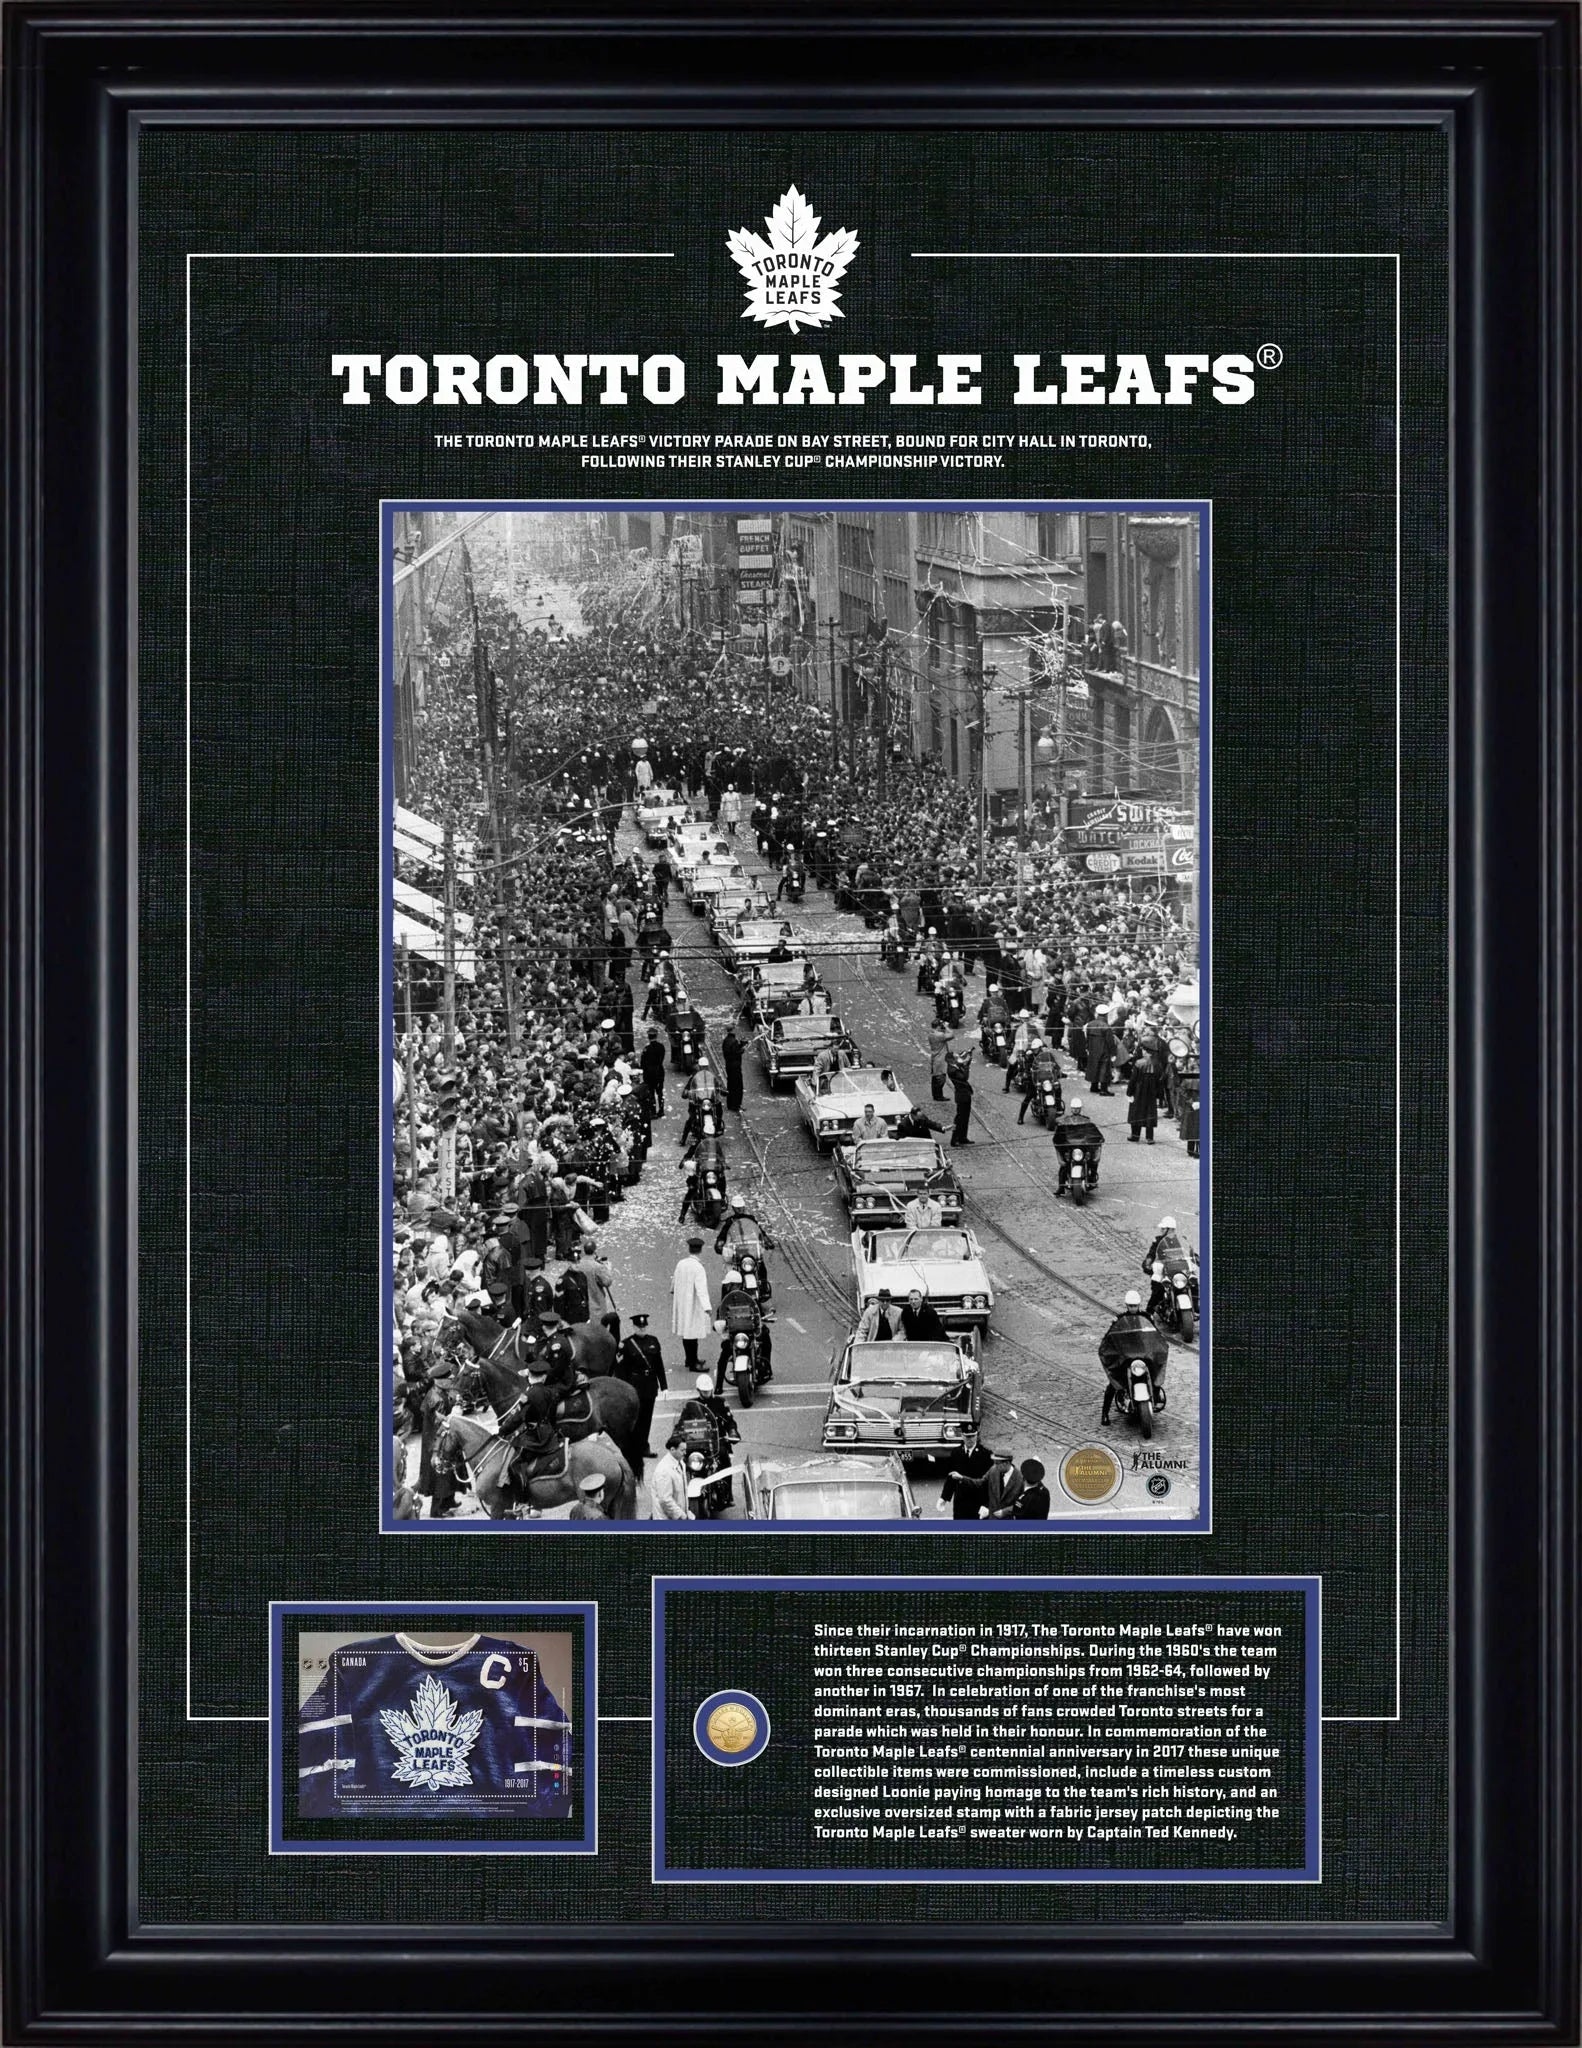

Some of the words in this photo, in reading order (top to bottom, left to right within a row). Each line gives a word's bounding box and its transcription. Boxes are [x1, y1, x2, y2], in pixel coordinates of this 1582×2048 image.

[752, 253, 835, 277] TORONTO
[766, 275, 821, 288] MAPLE
[766, 291, 821, 304] LEAFS
[332, 355, 685, 404] TORONTO
[717, 355, 981, 404] MAPLE
[434, 435, 462, 447] THE
[466, 435, 534, 447] TORONTO
[539, 435, 587, 447] MAPLE
[649, 435, 710, 447] VICTORY
[715, 435, 773, 447] PARADE
[778, 435, 797, 447] ON
[802, 435, 829, 447] BAY
[834, 435, 891, 449] STREET,
[896, 435, 945, 447] BOUND
[950, 435, 977, 447] FOR
[983, 435, 1015, 447] CITY
[1019, 435, 1056, 447] HALL
[1061, 436, 1075, 447] IN
[1079, 435, 1151, 449] TORONTO,
[582, 455, 664, 467] FOLLOWING
[669, 456, 711, 467] THEIR
[717, 455, 780, 467] STANLEY
[826, 455, 937, 467] CHAMPIONSHIP
[940, 456, 1004, 467] VICTORY.
[1127, 856, 1158, 865] Kodak
[1142, 1452, 1161, 1461] THE
[1141, 1461, 1188, 1469] ALUMNI
[815, 1624, 853, 1636] Since
[857, 1624, 890, 1636] their
[895, 1624, 975, 1636] incarnation
[981, 1624, 992, 1636] in
[997, 1624, 1028, 1638] 1917,
[1032, 1624, 1057, 1636] The
[1061, 1624, 1115, 1636] Toronto
[1120, 1624, 1161, 1639] Maple
[1218, 1624, 1249, 1636] have
[1254, 1628, 1281, 1636] won
[814, 1644, 870, 1656] thirteen
[875, 1645, 928, 1659] Stanley
[971, 1644, 1084, 1659] Championships.
[1090, 1644, 1135, 1659] During
[1139, 1645, 1161, 1656] the
[1166, 1645, 1210, 1656] 1960's
[1214, 1645, 1236, 1656] the
[1241, 1646, 1276, 1656] team
[342, 1657, 367, 1667] CANADA
[480, 1653, 512, 1690] C
[814, 1668, 841, 1676] won
[846, 1665, 882, 1676] three
[888, 1664, 972, 1676] consecutive
[977, 1664, 1085, 1679] championships
[1089, 1665, 1122, 1676] from
[1127, 1665, 1185, 1678] 1962-64,
[1190, 1664, 1249, 1676] followed
[1255, 1665, 1270, 1679] by
[815, 1685, 869, 1696] another
[874, 1685, 885, 1696] in
[890, 1685, 924, 1696] 1967.
[933, 1685, 945, 1696] In
[950, 1685, 1029, 1696] celebration
[1035, 1685, 1048, 1696] of
[1053, 1688, 1078, 1696] one
[1083, 1685, 1096, 1696] of
[1100, 1685, 1123, 1696] the
[1127, 1685, 1205, 1696] franchise's
[1210, 1686, 1245, 1696] most
[815, 1705, 881, 1716] dominant
[886, 1708, 920, 1718] eras,
[924, 1705, 999, 1716] thousands
[1004, 1705, 1017, 1716] of
[1022, 1705, 1052, 1716] fans
[1057, 1705, 1115, 1716] crowded
[1119, 1705, 1173, 1716] Toronto
[1178, 1706, 1227, 1716] streets
[1231, 1705, 1251, 1716] for
[1256, 1708, 1263, 1716] a
[403, 1729, 464, 1748] TORONTO
[815, 1725, 862, 1740] parade
[867, 1725, 907, 1737] which
[911, 1729, 937, 1737] was
[942, 1725, 971, 1737] held
[977, 1725, 988, 1737] in
[993, 1725, 1026, 1737] their
[1031, 1725, 1083, 1737] honour.
[1088, 1725, 1100, 1737] In
[1106, 1725, 1221, 1737] commemoration
[1226, 1725, 1240, 1737] of
[1244, 1725, 1266, 1737] the
[415, 1747, 453, 1758] MAPLE
[814, 1745, 868, 1757] Toronto
[873, 1745, 914, 1760] Maple
[971, 1745, 1044, 1757] centennial
[1050, 1745, 1132, 1760] anniversary
[1137, 1745, 1148, 1757] in
[1154, 1745, 1184, 1757] 2017
[1188, 1745, 1227, 1757] these
[1232, 1745, 1279, 1760] unique
[413, 1760, 456, 1771] LEAFS
[815, 1765, 888, 1777] collectible
[893, 1765, 932, 1777] items
[936, 1769, 968, 1777] were
[974, 1765, 1080, 1779] commissioned,
[1086, 1765, 1136, 1777] include
[1142, 1769, 1149, 1777] a
[1153, 1765, 1214, 1777] timeless
[1219, 1767, 1270, 1777] custom
[815, 1785, 878, 1800] designed
[883, 1786, 930, 1797] Loonie
[935, 1786, 980, 1800] paying
[986, 1786, 1041, 1801] homage
[1045, 1787, 1059, 1797] to
[1064, 1786, 1086, 1797] the
[1091, 1786, 1138, 1797] team's
[1143, 1786, 1168, 1797] rich
[1174, 1786, 1226, 1800] history,
[1231, 1786, 1256, 1797] and
[1261, 1789, 1277, 1797] an
[815, 1806, 880, 1817] exclusive
[885, 1806, 952, 1817] oversized
[957, 1807, 1000, 1821] stamp
[1005, 1806, 1033, 1817] with
[1039, 1809, 1046, 1817] a
[1050, 1806, 1091, 1817] fabric
[1095, 1806, 1138, 1820] jersey
[1143, 1806, 1181, 1821] patch
[1187, 1806, 1252, 1821] depicting
[1256, 1806, 1279, 1817] the
[814, 1826, 868, 1837] Toronto
[873, 1826, 915, 1841] Maple
[971, 1827, 1026, 1838] sweater
[1029, 1829, 1062, 1837] worn
[1068, 1826, 1083, 1840] by
[1088, 1826, 1141, 1841] Captain
[1145, 1826, 1168, 1837] Ted
[1174, 1826, 1237, 1841] Kennedy.
